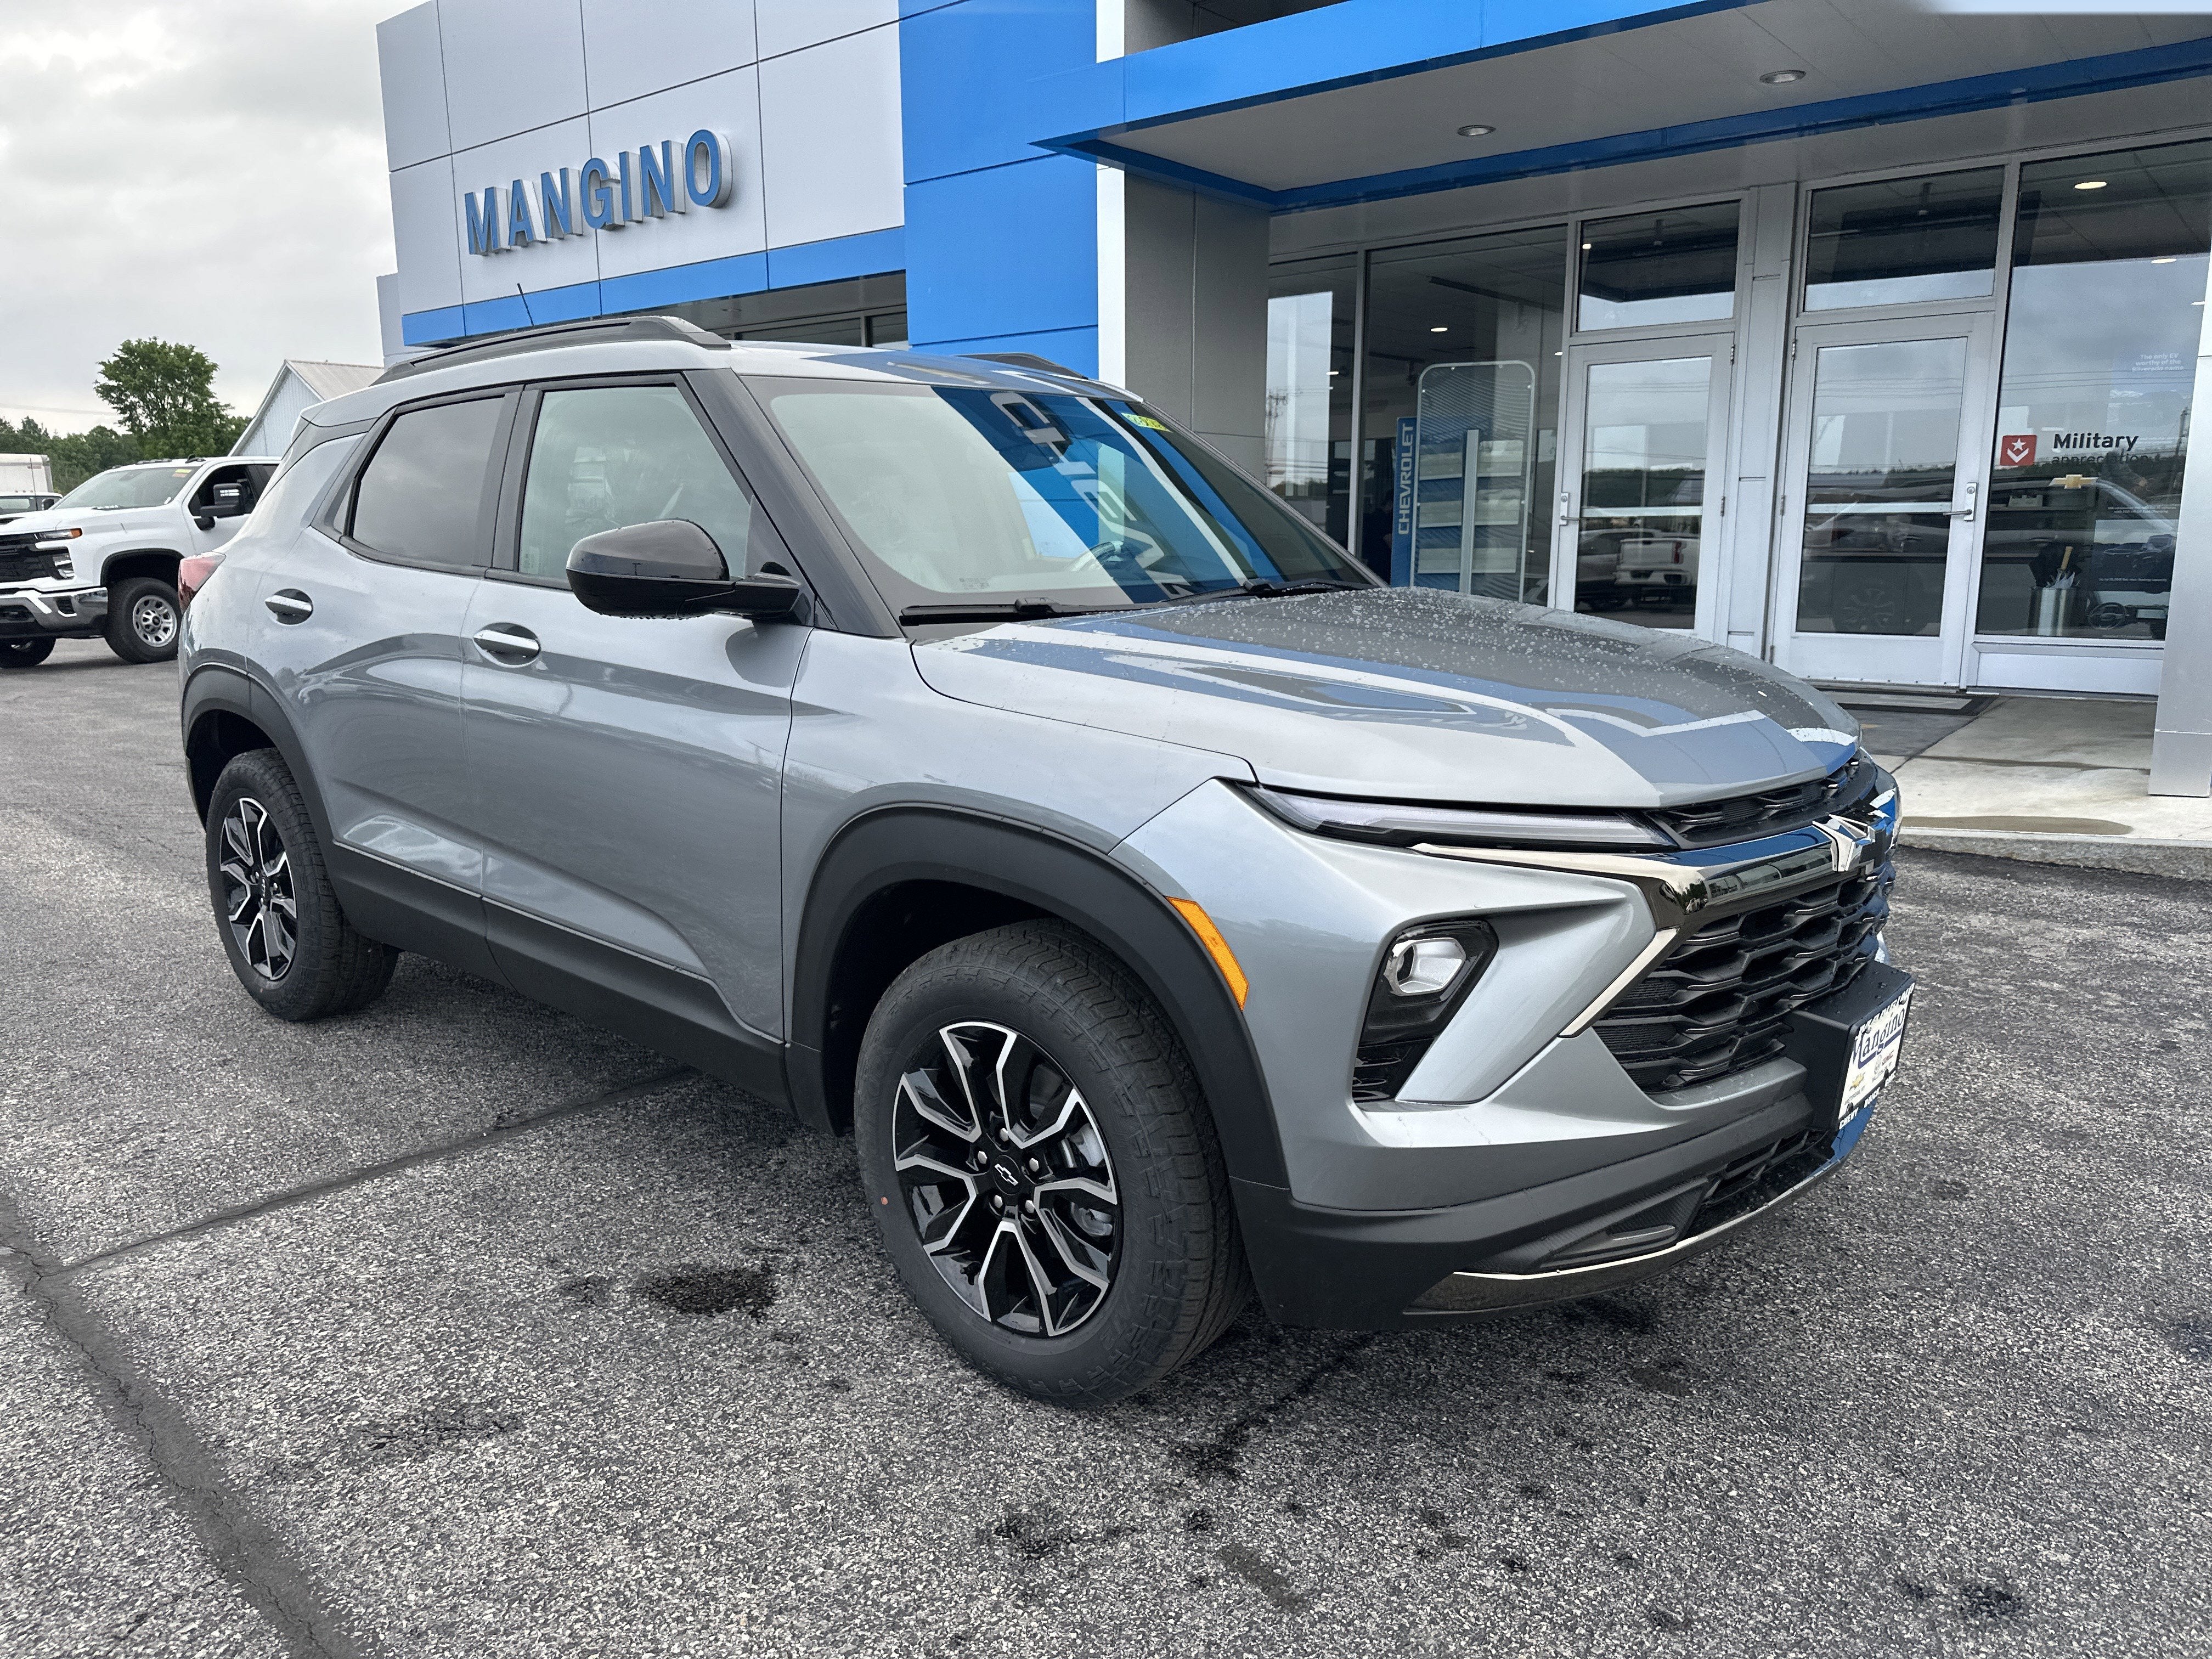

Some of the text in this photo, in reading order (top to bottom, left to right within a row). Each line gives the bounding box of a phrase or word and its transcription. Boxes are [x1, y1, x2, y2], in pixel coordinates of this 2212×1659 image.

[465, 129, 732, 256] MANGINO
[2051, 454, 2149, 467] apprection
[2053, 432, 2139, 452] Military
[1398, 423, 1414, 535] CHEVROLET
[1853, 1008, 1905, 1069] Mangino
[1838, 1107, 1859, 1130] CHEVY
